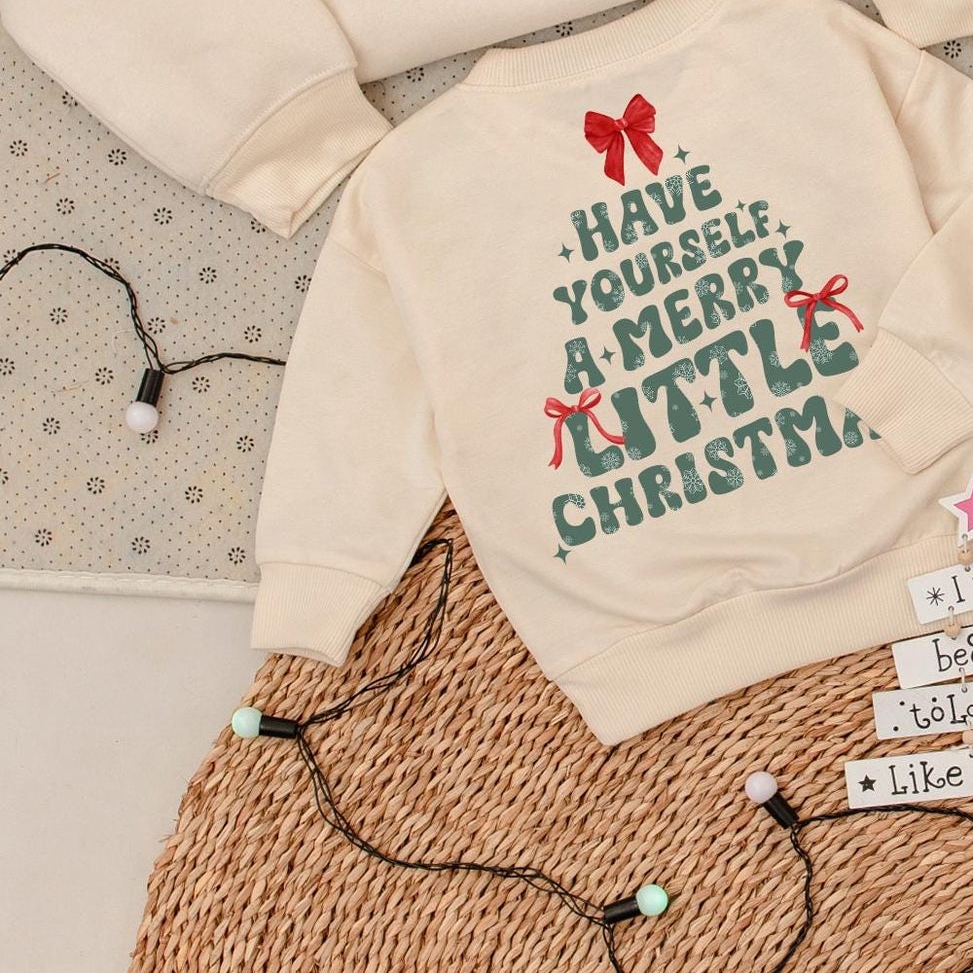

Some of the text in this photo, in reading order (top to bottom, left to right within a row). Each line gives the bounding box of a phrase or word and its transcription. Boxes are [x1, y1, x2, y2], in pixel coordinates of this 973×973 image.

[553, 200, 769, 325] YOURSELF
[570, 165, 722, 262] HAVE
[564, 240, 804, 394] A MERRY
[565, 297, 859, 477] LITTLE
[909, 702, 945, 729] to
[888, 761, 964, 796] Like
